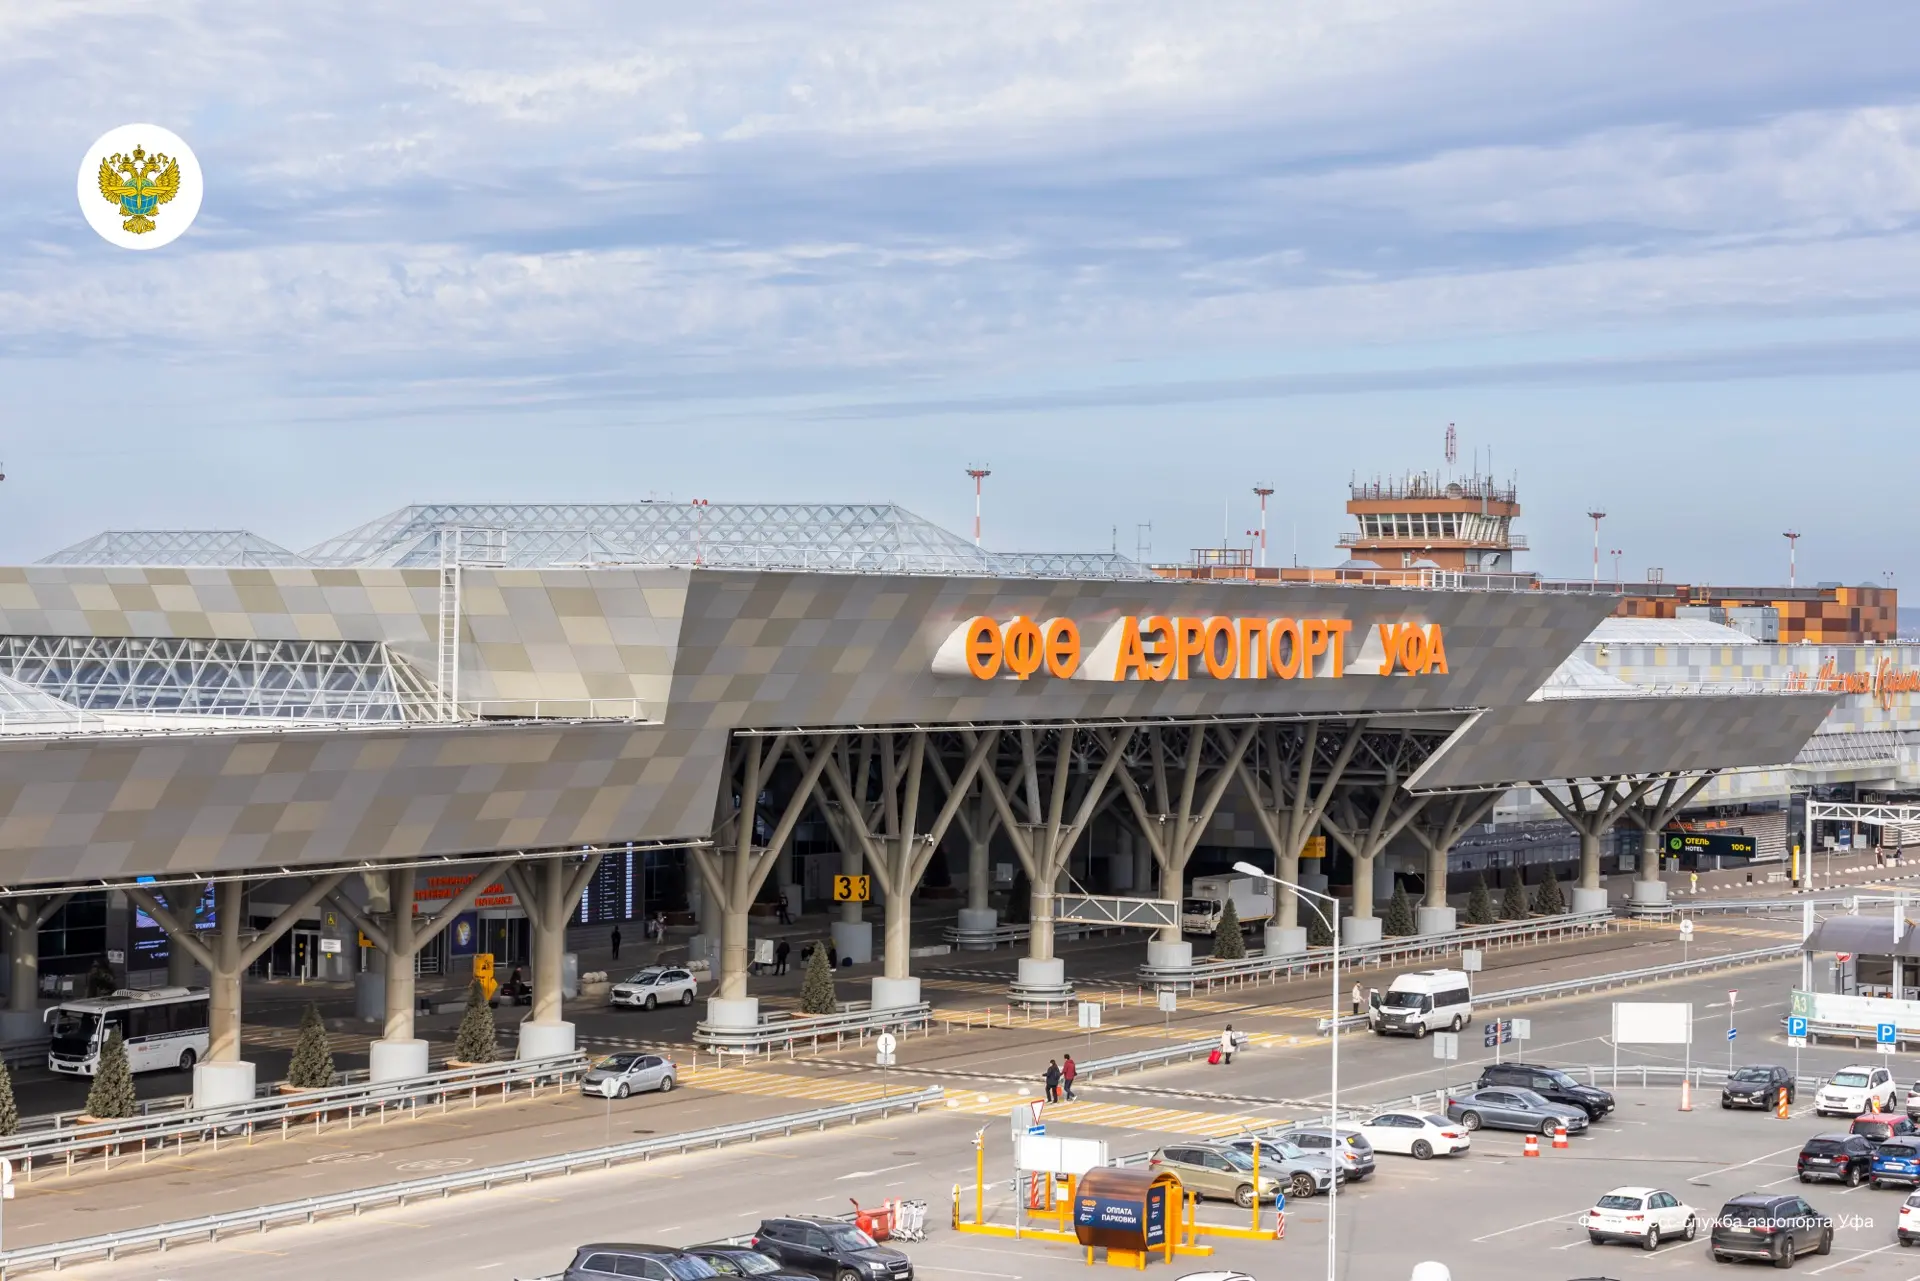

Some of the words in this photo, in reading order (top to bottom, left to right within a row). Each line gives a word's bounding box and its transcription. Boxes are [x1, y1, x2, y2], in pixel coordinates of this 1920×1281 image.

[1113, 615, 1353, 681] АЭРОПОРТ
[1379, 621, 1449, 677] УФА
[1685, 837, 1709, 845] ОТЕЛЬ
[1793, 1019, 1804, 1034] P
[1882, 1026, 1893, 1040] P
[1106, 1206, 1132, 1215] ОПЛАТА
[1101, 1214, 1137, 1224] ПАРКОВКИ
